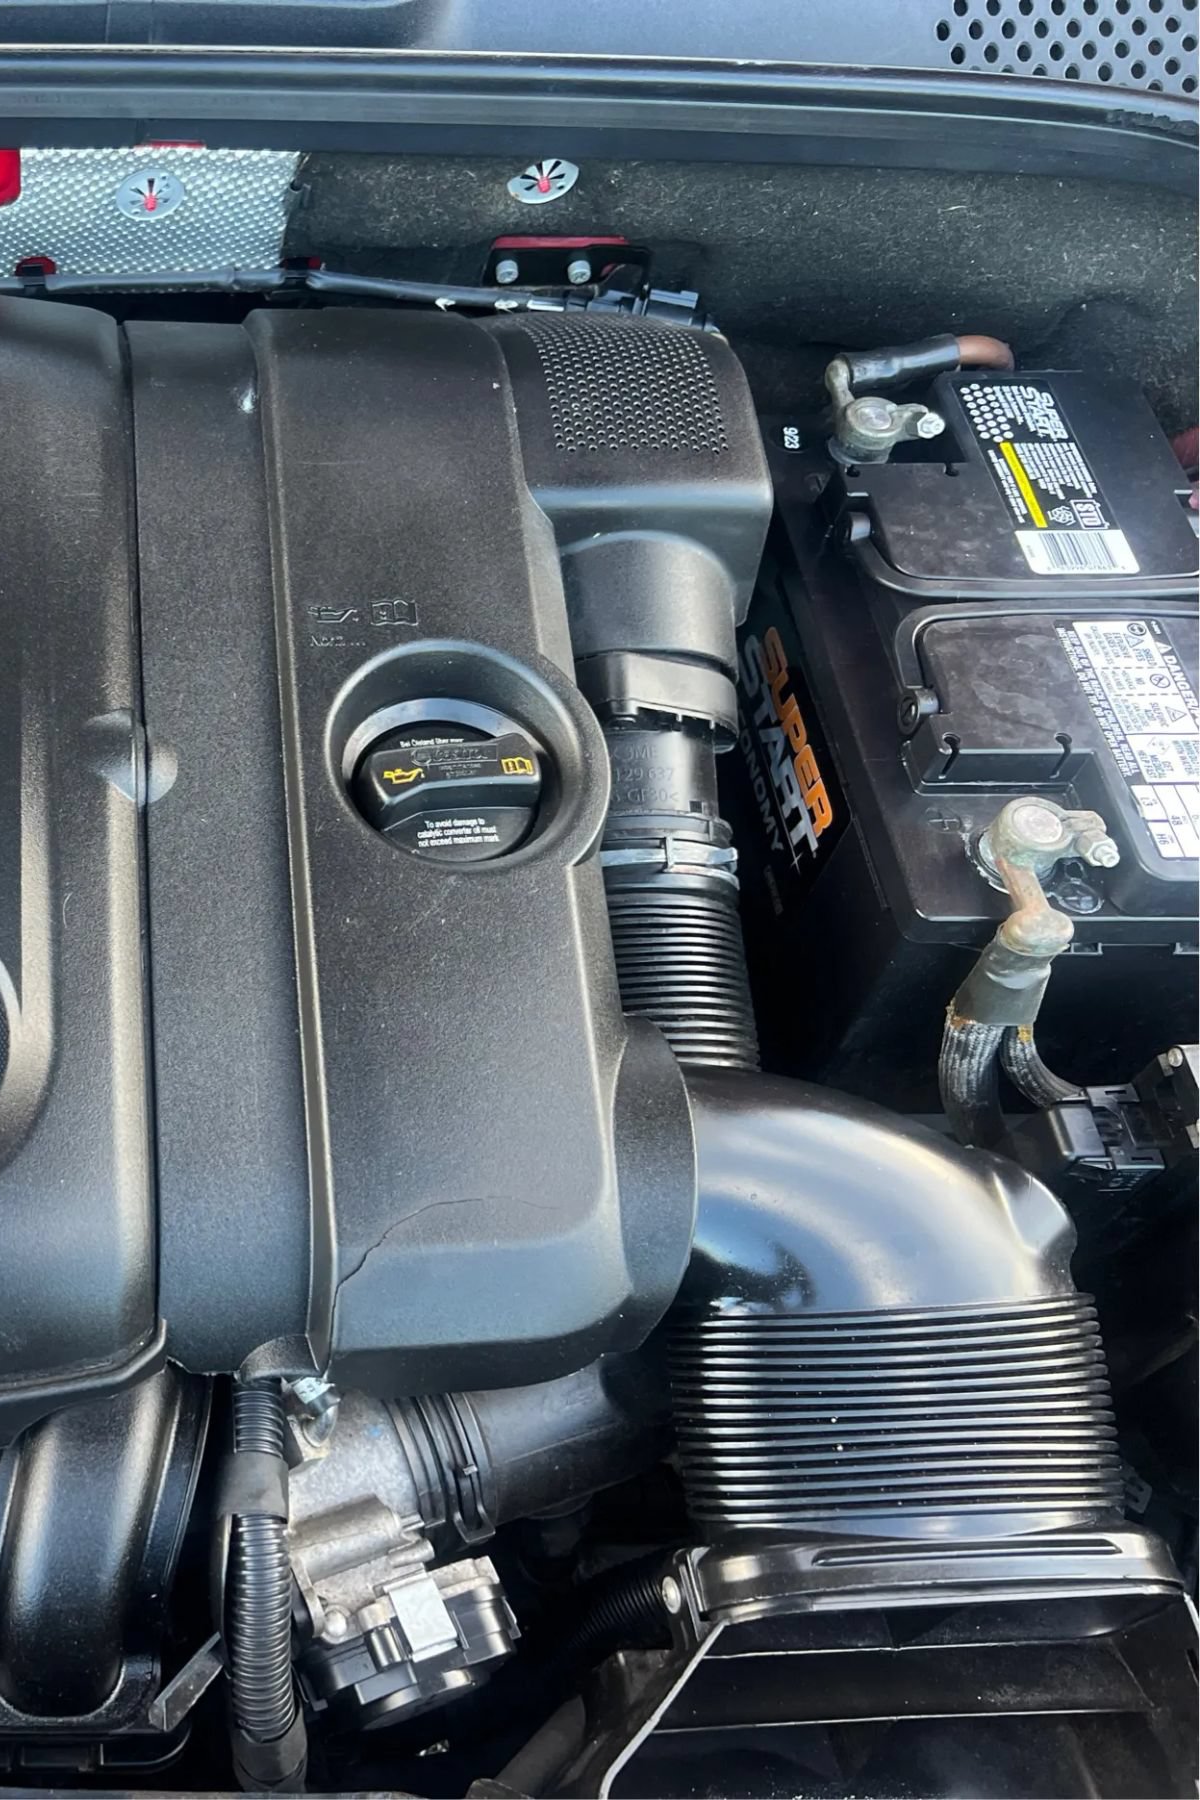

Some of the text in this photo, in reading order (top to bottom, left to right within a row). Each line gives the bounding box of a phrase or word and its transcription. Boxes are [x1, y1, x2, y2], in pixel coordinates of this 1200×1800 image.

[1018, 385, 1057, 437] START
[1036, 391, 1069, 440] SUPER
[783, 426, 800, 449] 9/23
[1075, 503, 1102, 526] STD
[744, 634, 818, 851] START
[763, 627, 833, 837] SUPER
[739, 709, 784, 850] ONOMY
[424, 820, 434, 828] To
[1156, 833, 1169, 845] H6
